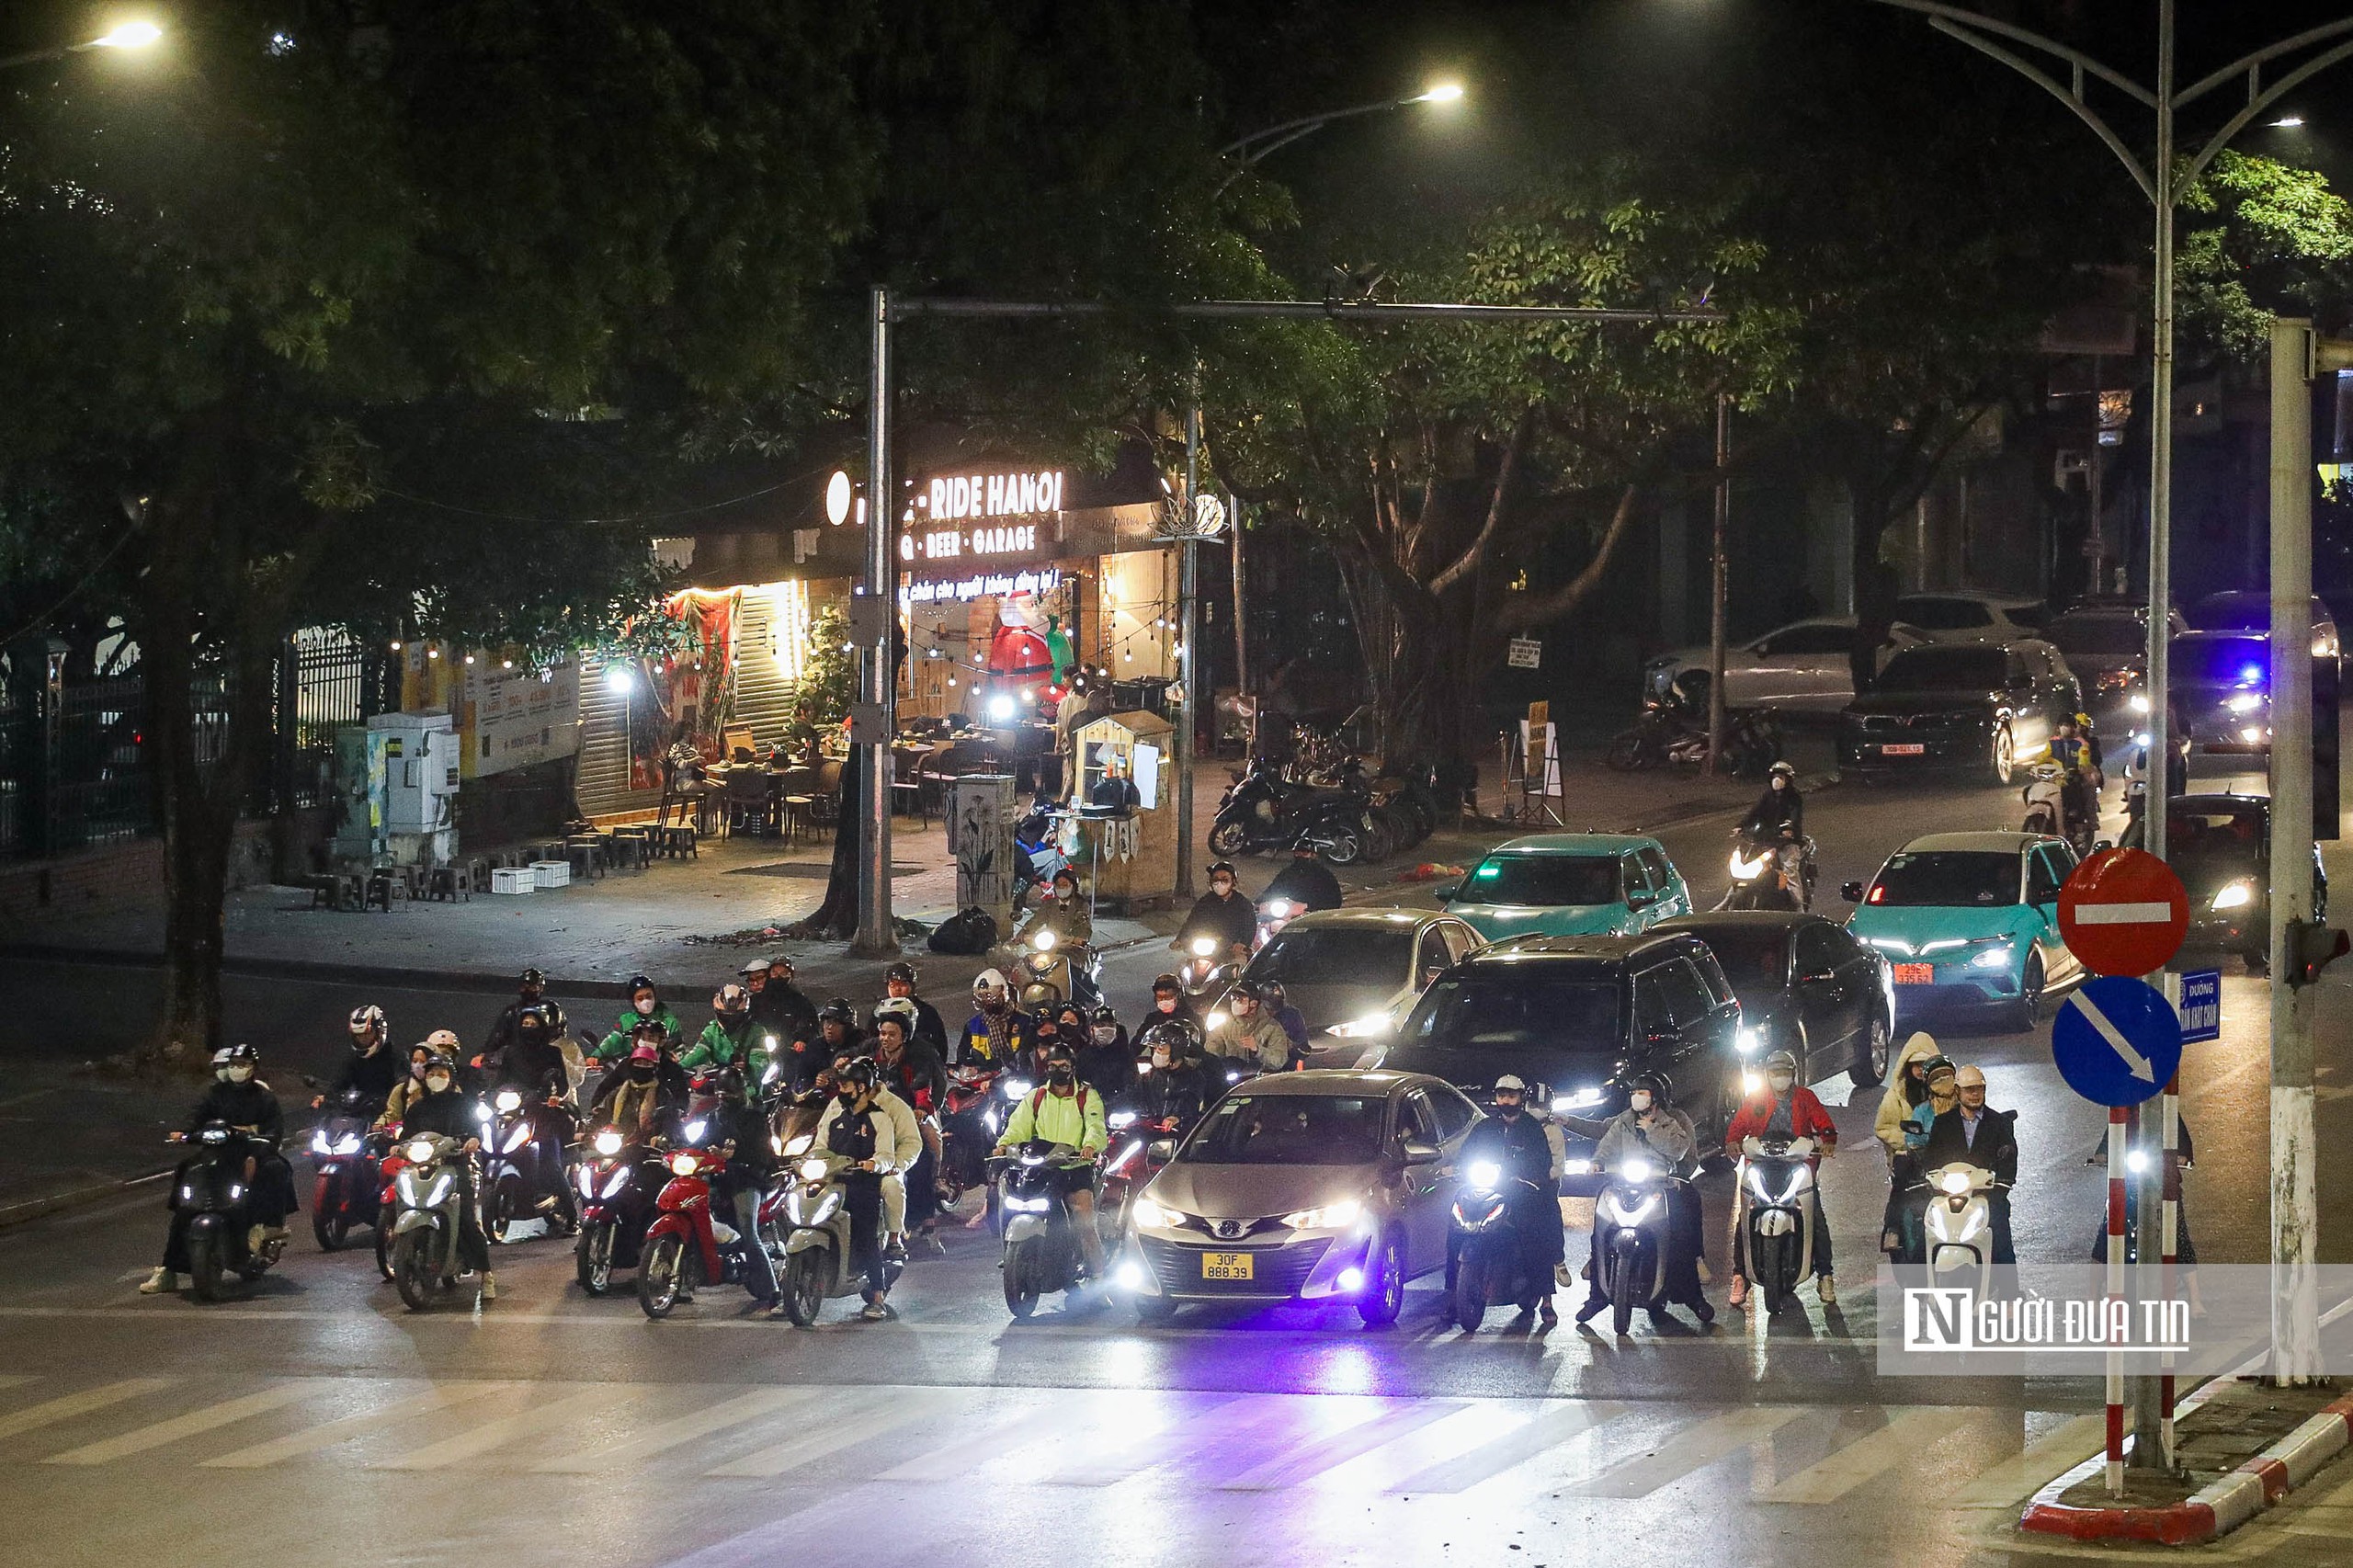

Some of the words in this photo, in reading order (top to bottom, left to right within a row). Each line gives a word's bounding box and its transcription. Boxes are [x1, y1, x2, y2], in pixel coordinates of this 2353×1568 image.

[930, 475, 983, 520] RIDE
[926, 531, 961, 558] BEER
[972, 525, 1036, 554] GARAGE
[936, 580, 955, 599] cho
[1216, 1254, 1238, 1266] 30F
[1208, 1266, 1248, 1278] 888.39
